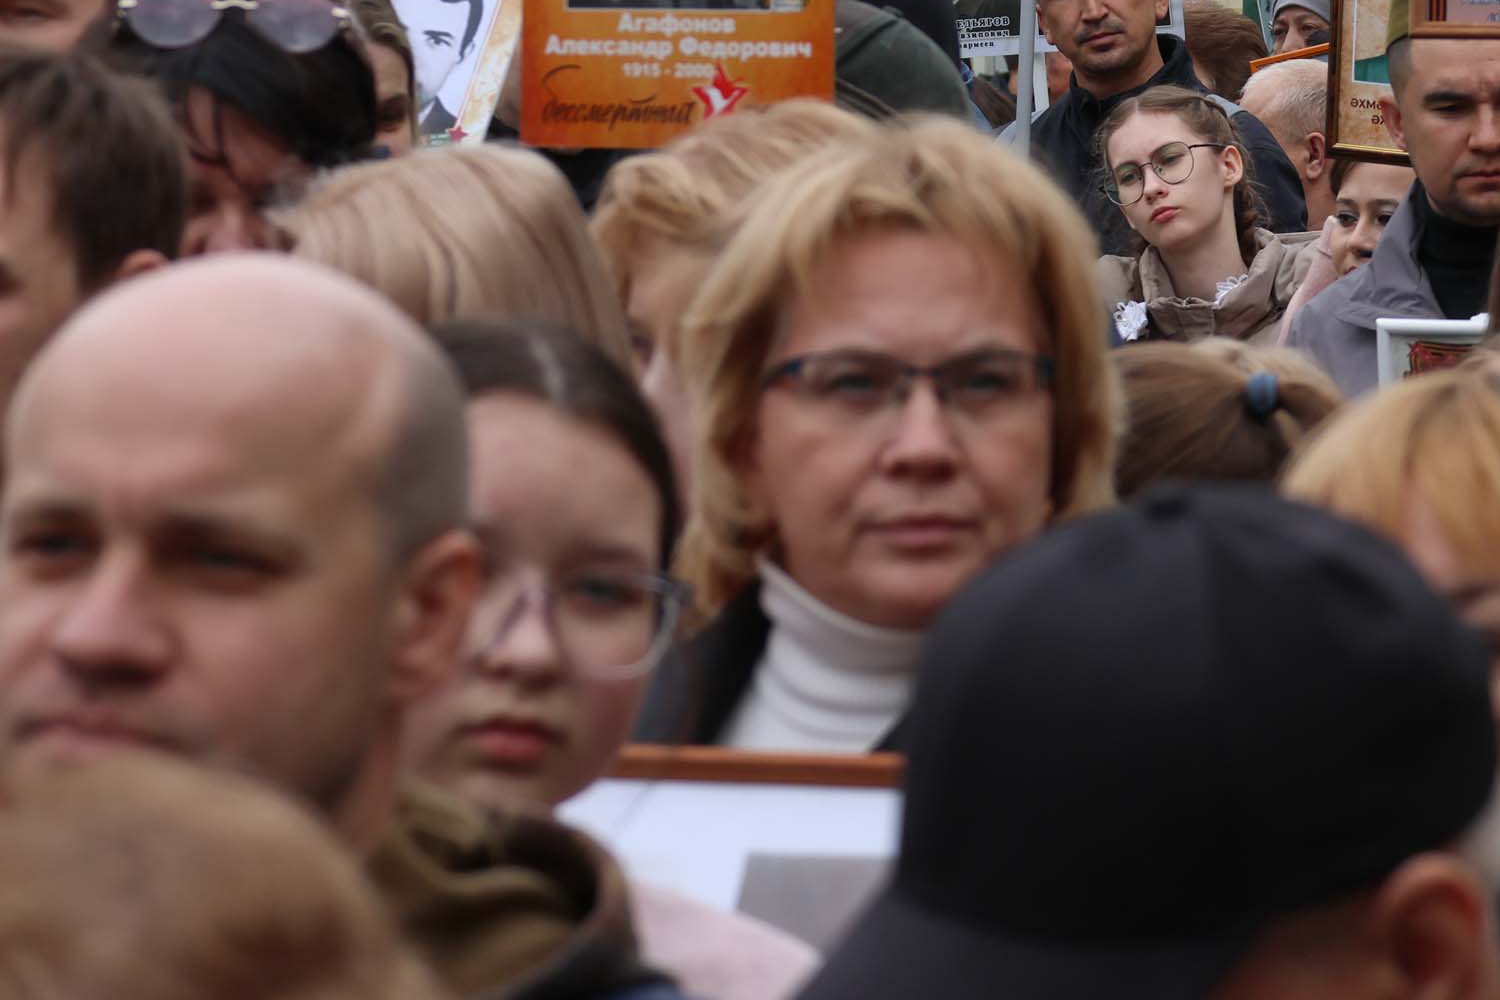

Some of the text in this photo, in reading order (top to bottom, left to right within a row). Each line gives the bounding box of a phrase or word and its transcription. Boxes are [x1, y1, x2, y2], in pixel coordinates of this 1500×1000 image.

[617, 12, 736, 37] Агафонов
[545, 35, 812, 61] Александр Федорович
